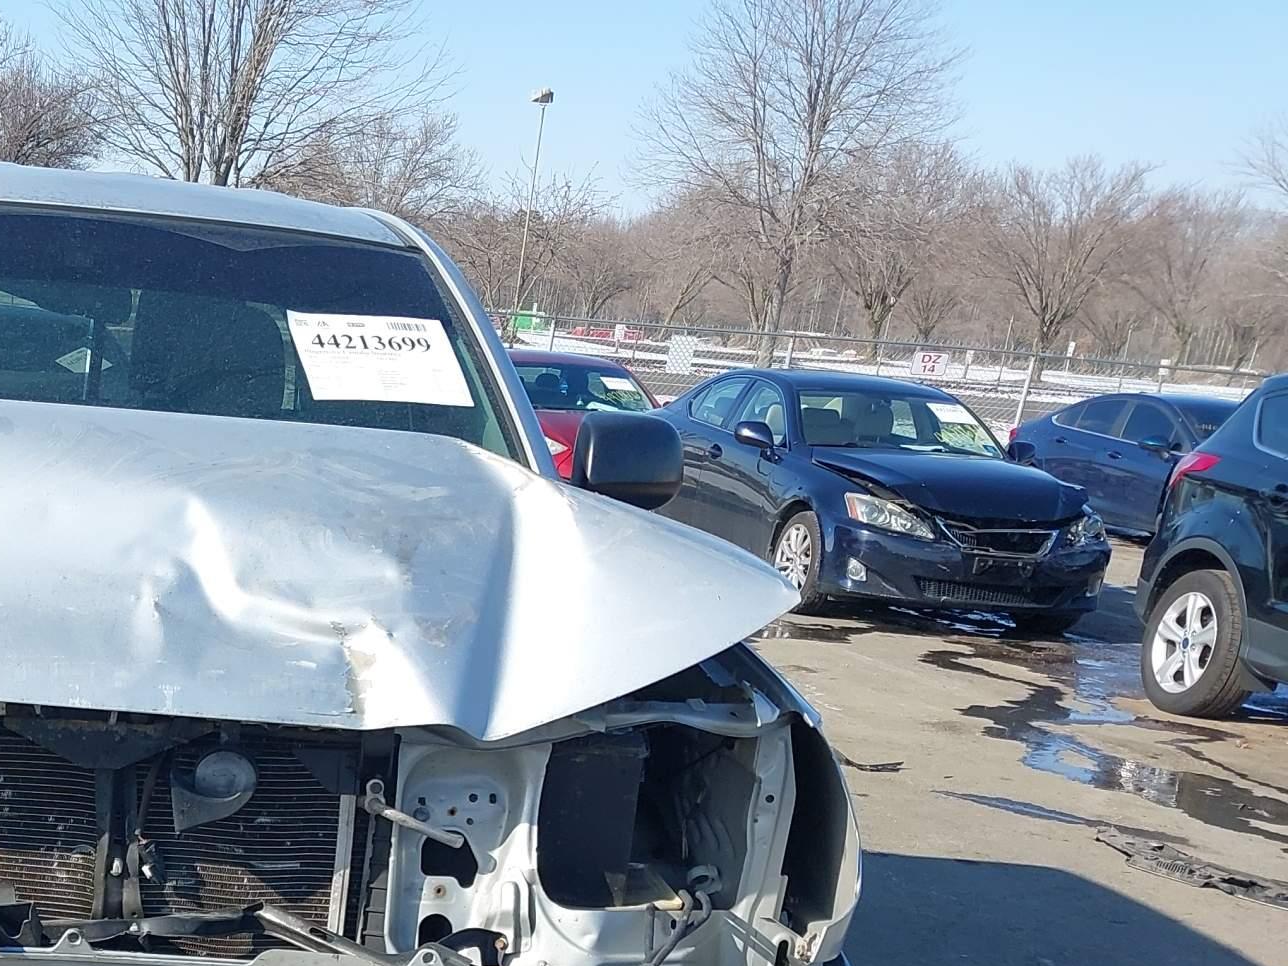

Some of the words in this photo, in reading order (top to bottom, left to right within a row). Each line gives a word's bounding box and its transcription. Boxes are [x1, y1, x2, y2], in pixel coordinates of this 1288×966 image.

[312, 333, 431, 353] 44213699
[921, 354, 942, 364] DZ
[921, 365, 935, 373] 14
